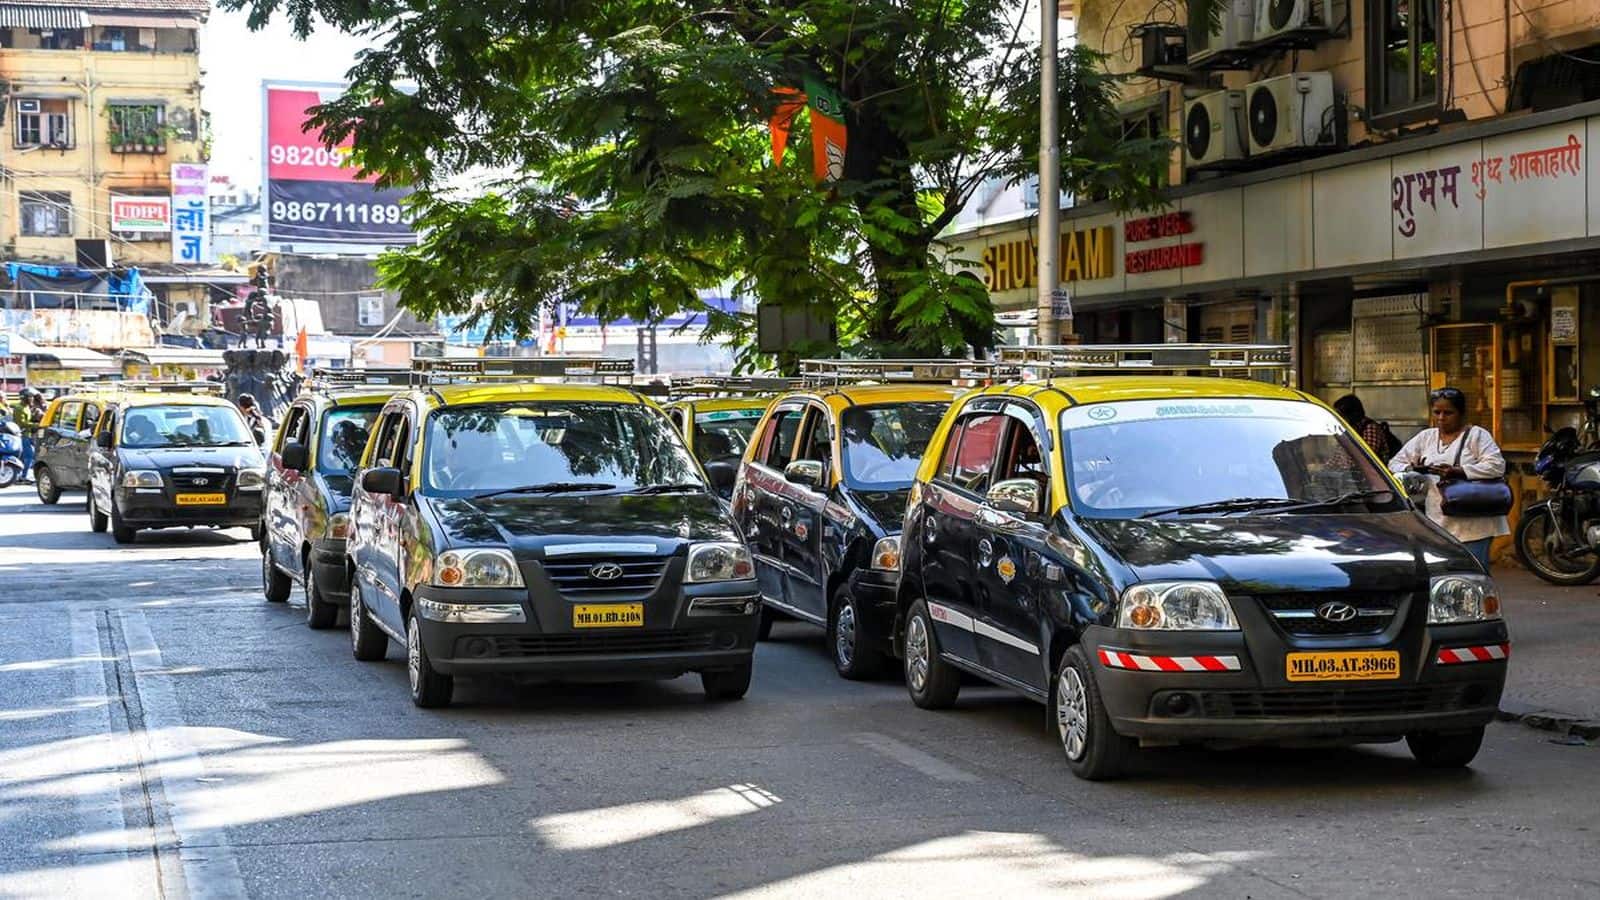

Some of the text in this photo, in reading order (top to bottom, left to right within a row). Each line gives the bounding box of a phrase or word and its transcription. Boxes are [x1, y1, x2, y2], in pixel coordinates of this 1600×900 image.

[1509, 134, 1582, 181] शाकाहारी
[1392, 166, 1462, 237] शुभम
[982, 226, 1109, 292] SHUAM
[1125, 242, 1201, 274] RESTAURANT
[1291, 657, 1396, 674] MH.03.AT.3966
